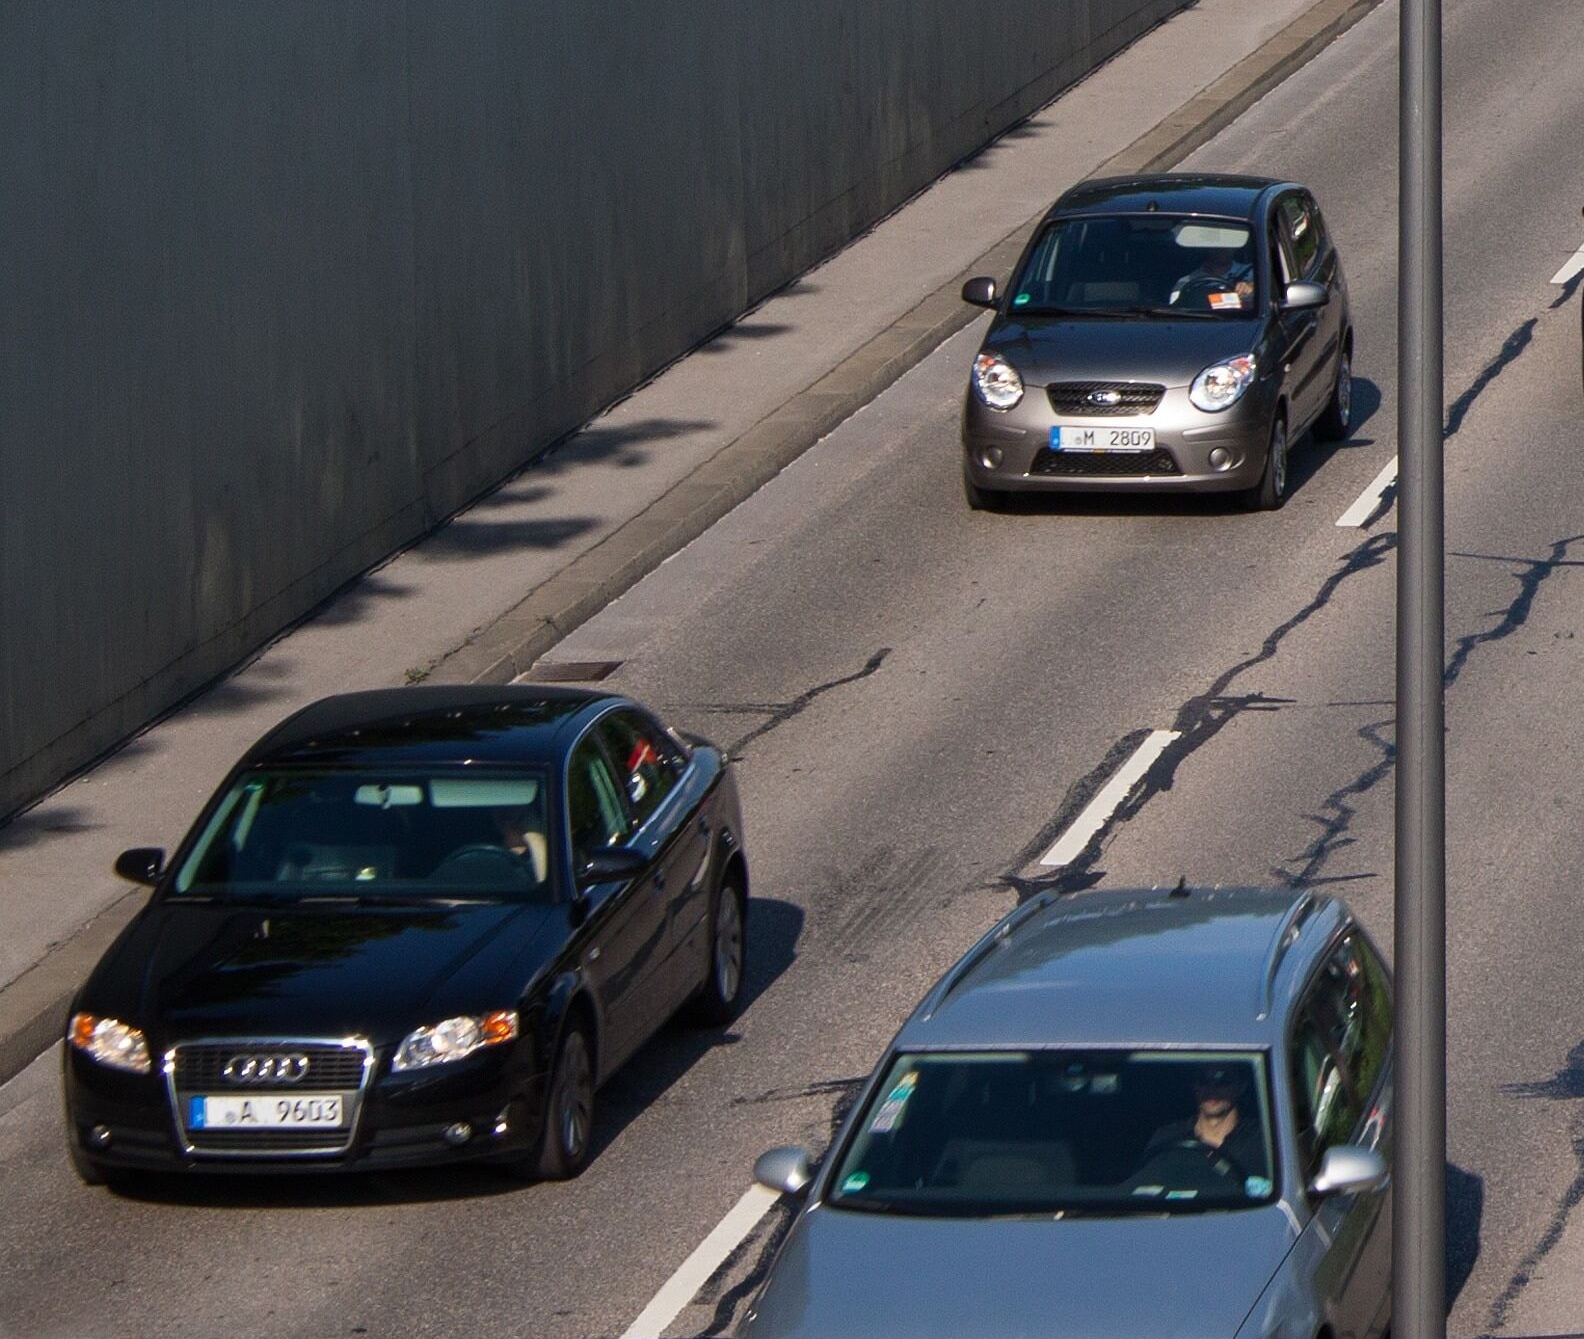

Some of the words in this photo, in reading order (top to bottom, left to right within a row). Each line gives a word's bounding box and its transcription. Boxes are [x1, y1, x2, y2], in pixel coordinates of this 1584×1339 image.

[1083, 432, 1095, 446] M
[1110, 431, 1152, 446] 2809
[278, 1099, 339, 1122] 9603
